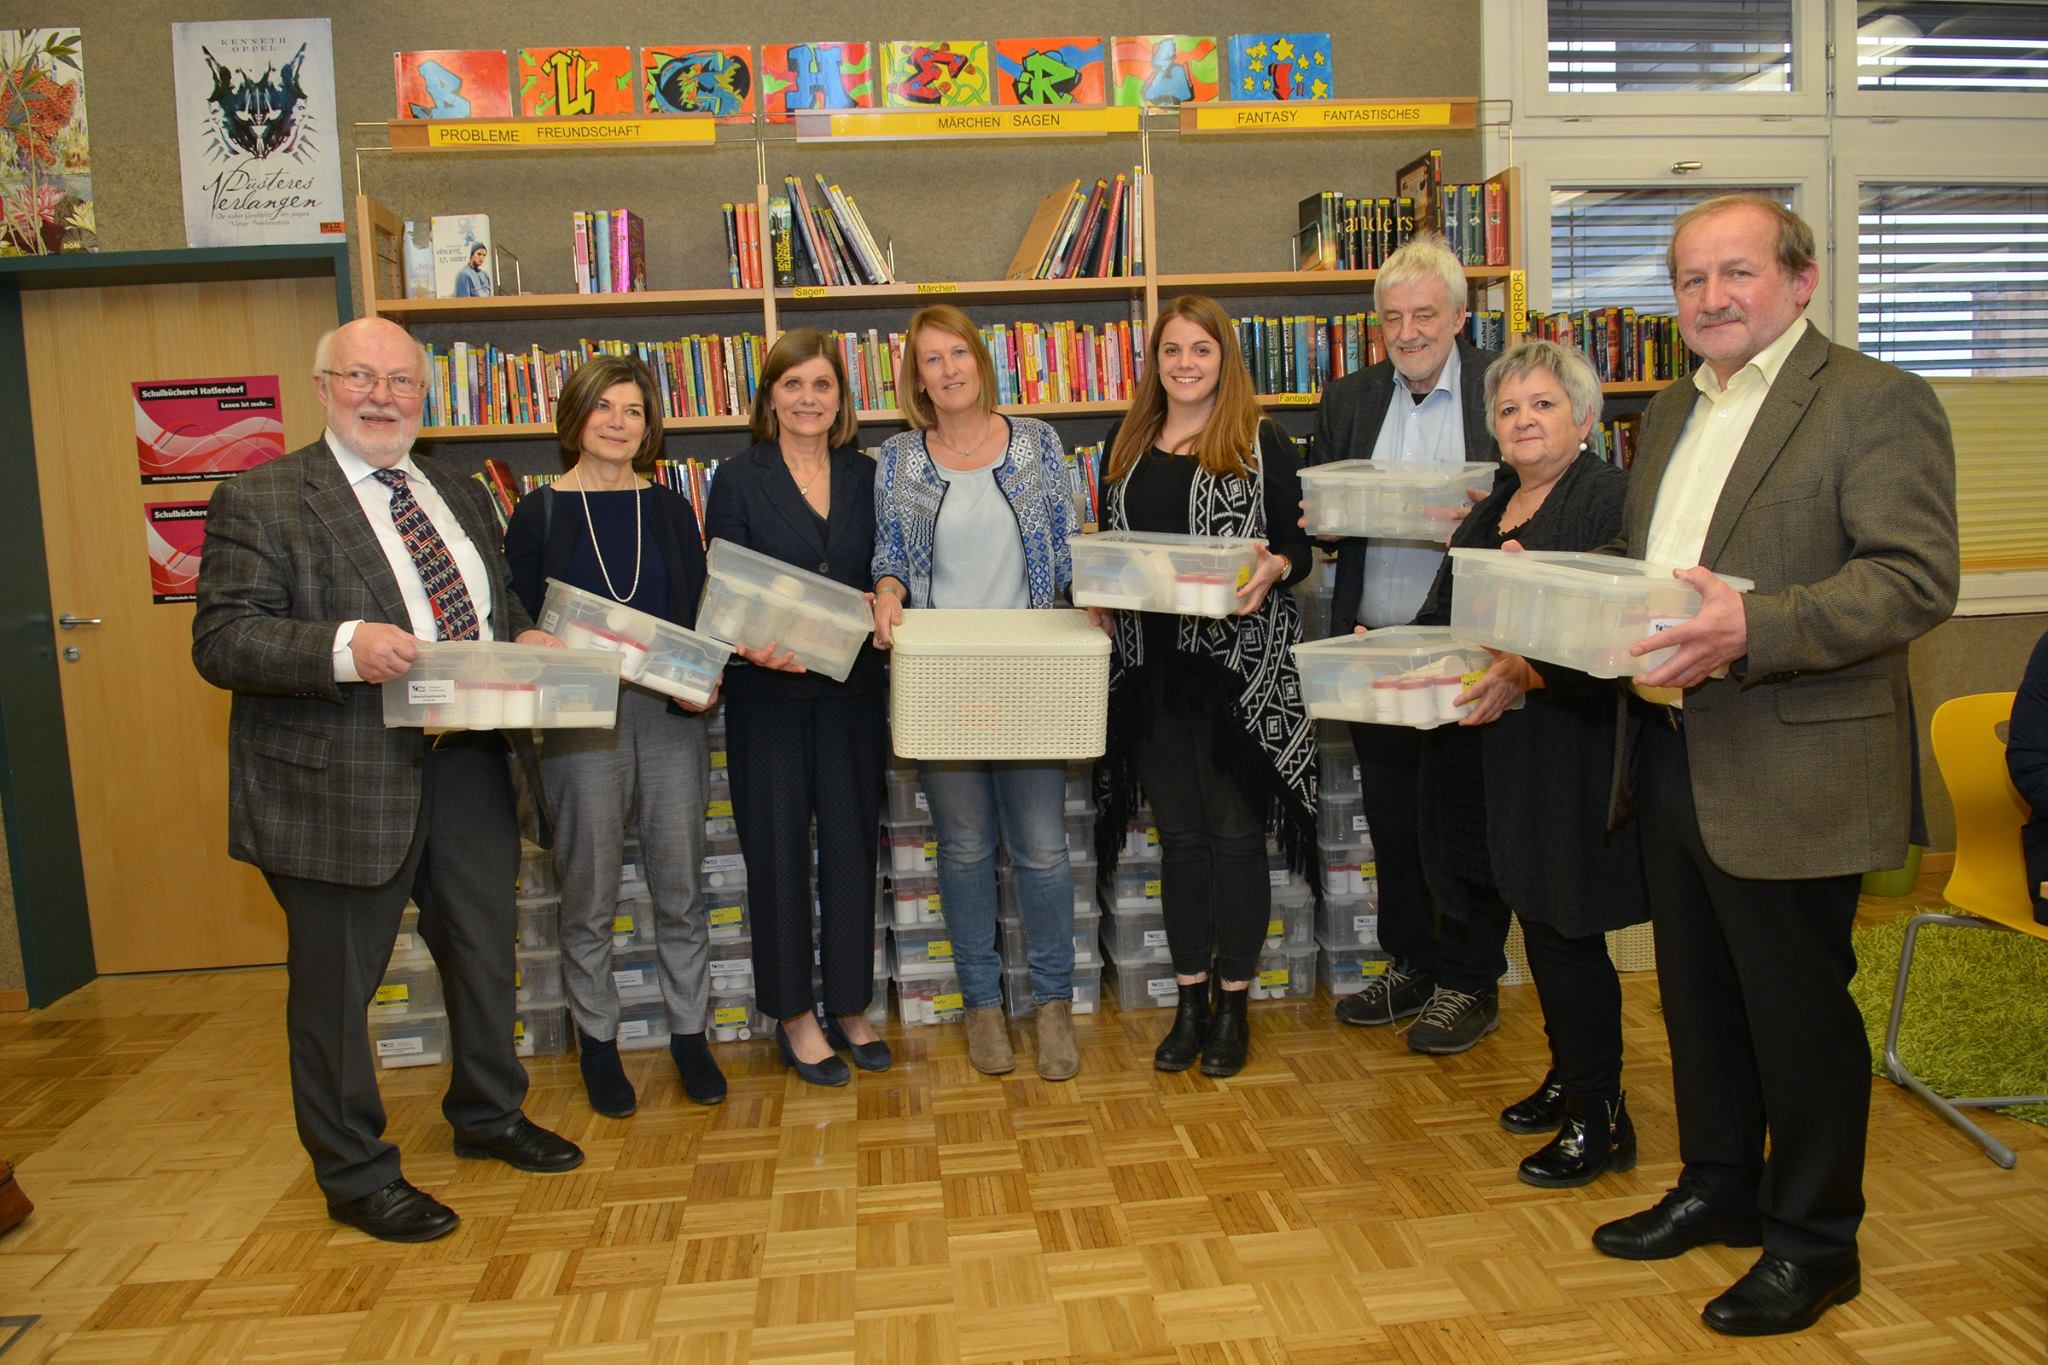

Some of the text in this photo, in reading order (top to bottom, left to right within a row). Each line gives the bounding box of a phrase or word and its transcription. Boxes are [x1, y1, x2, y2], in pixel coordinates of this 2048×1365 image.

[221, 37, 286, 46] KENNETH
[232, 45, 277, 53] OPPEL
[938, 114, 1061, 129] MÄRCHEN SAGEN
[1238, 108, 1421, 124] FANTASY FANTASTISCHES
[440, 125, 641, 142] PROBLEME FREUNDSCHAFT
[227, 167, 314, 191] Düsteres
[203, 172, 321, 222] Verlangen
[795, 287, 825, 298] Sagen
[917, 283, 956, 293] Märchen
[1513, 271, 1524, 332] HORROR
[142, 385, 244, 399] Schulbücherei Hatlerdorf
[241, 400, 250, 408] ist
[1280, 393, 1312, 404] Fantasy
[154, 509, 208, 519] Schulbüchere
